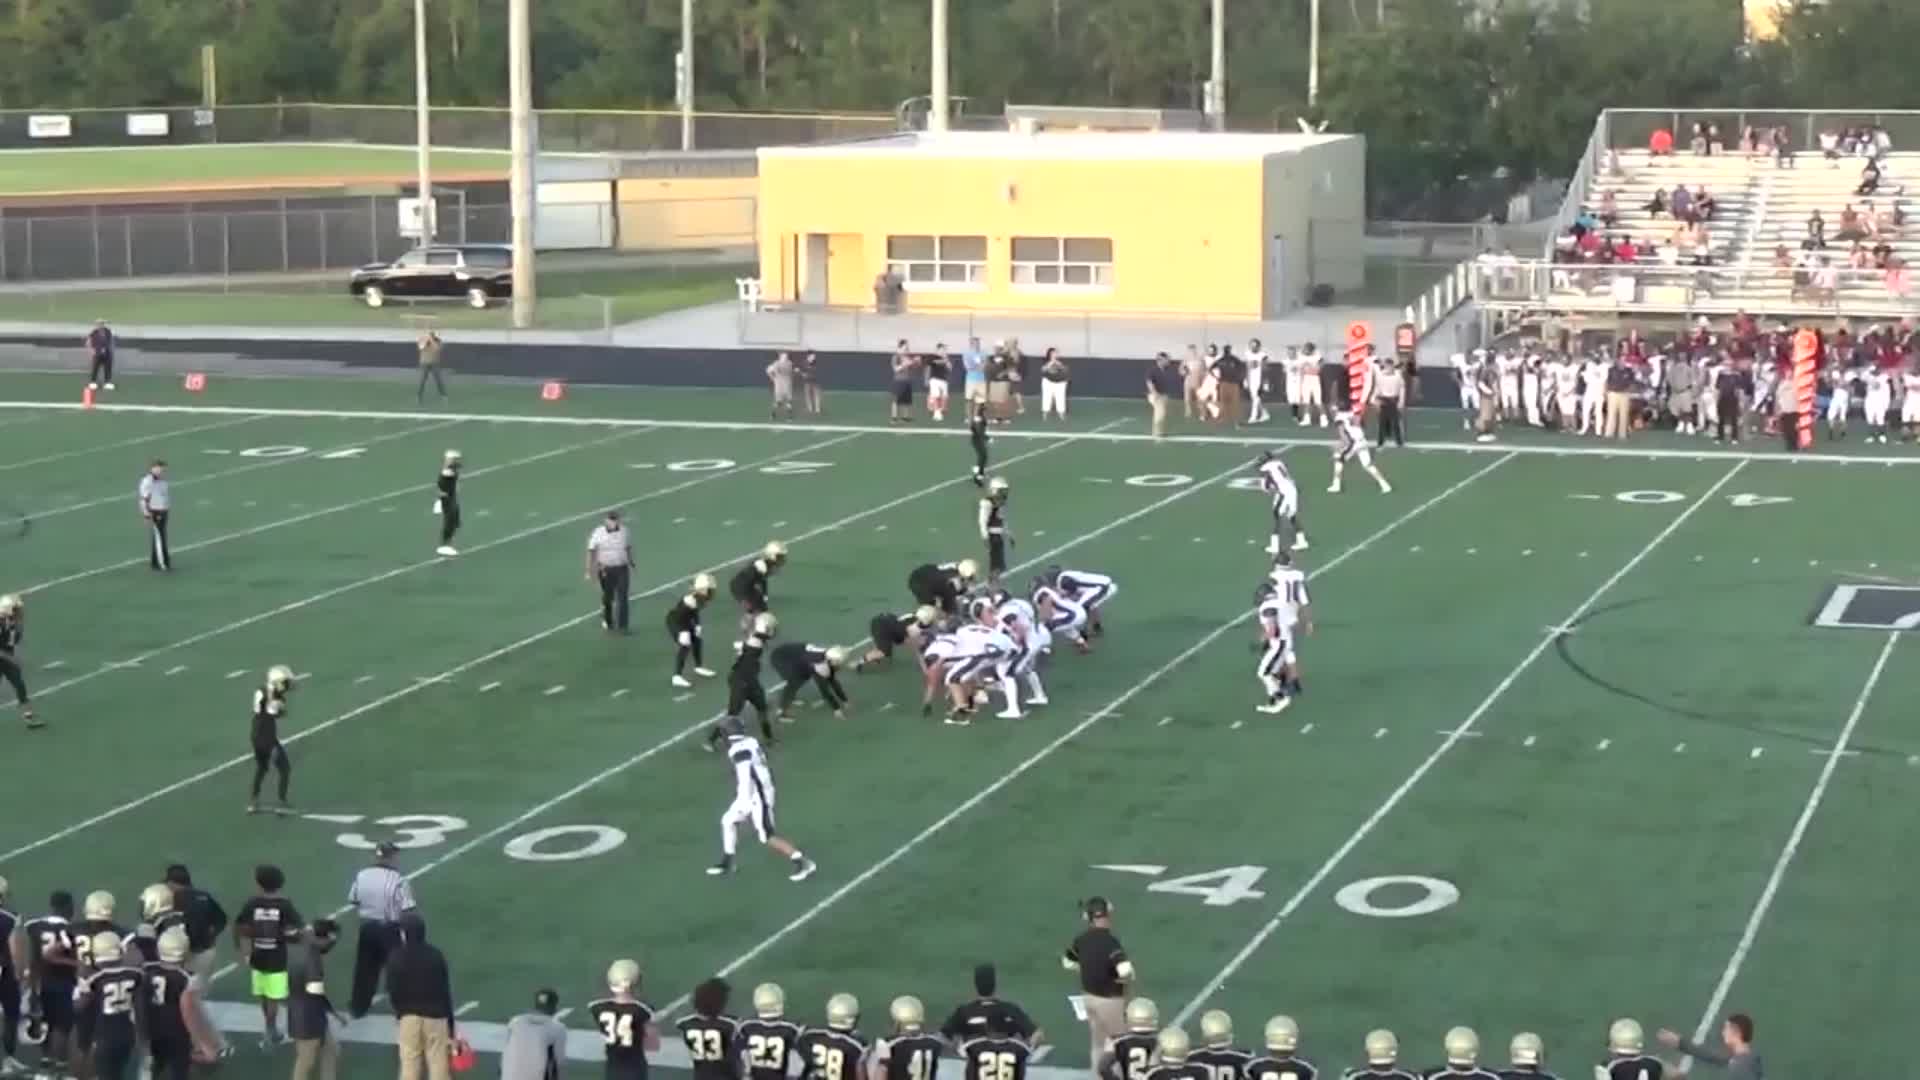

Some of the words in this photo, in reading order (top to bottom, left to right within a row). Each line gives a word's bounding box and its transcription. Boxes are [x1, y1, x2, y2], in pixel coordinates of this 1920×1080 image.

[103, 975, 135, 1015] 25
[600, 1011, 633, 1047] 34
[687, 1029, 723, 1061] 33
[749, 1034, 785, 1070] 23
[979, 1052, 1017, 1080] 26
